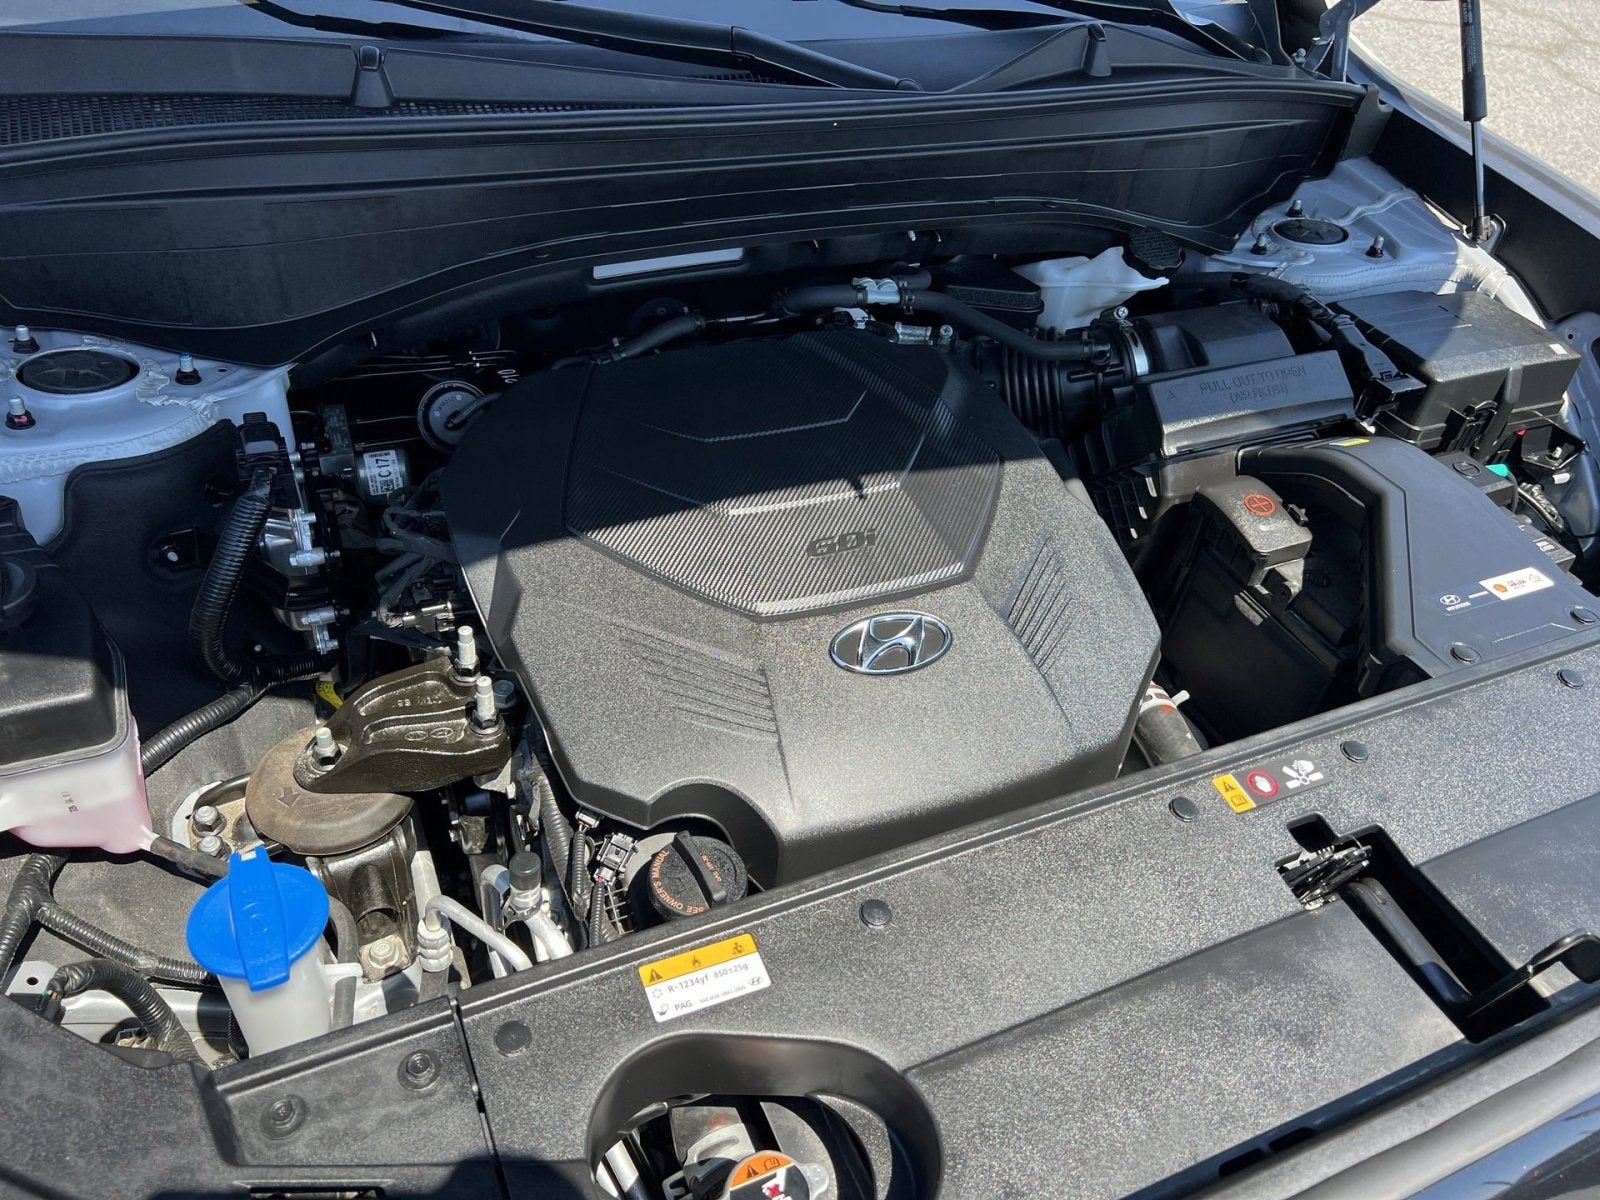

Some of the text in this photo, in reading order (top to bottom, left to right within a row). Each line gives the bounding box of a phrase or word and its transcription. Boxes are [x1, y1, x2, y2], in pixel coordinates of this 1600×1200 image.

[1200, 379, 1231, 394] PULL
[1232, 373, 1255, 388] OUT
[652, 850, 705, 914] SEE OWNER'S MANUAL
[667, 974, 710, 994] R-1234yf
[674, 1000, 693, 1012] PAG
